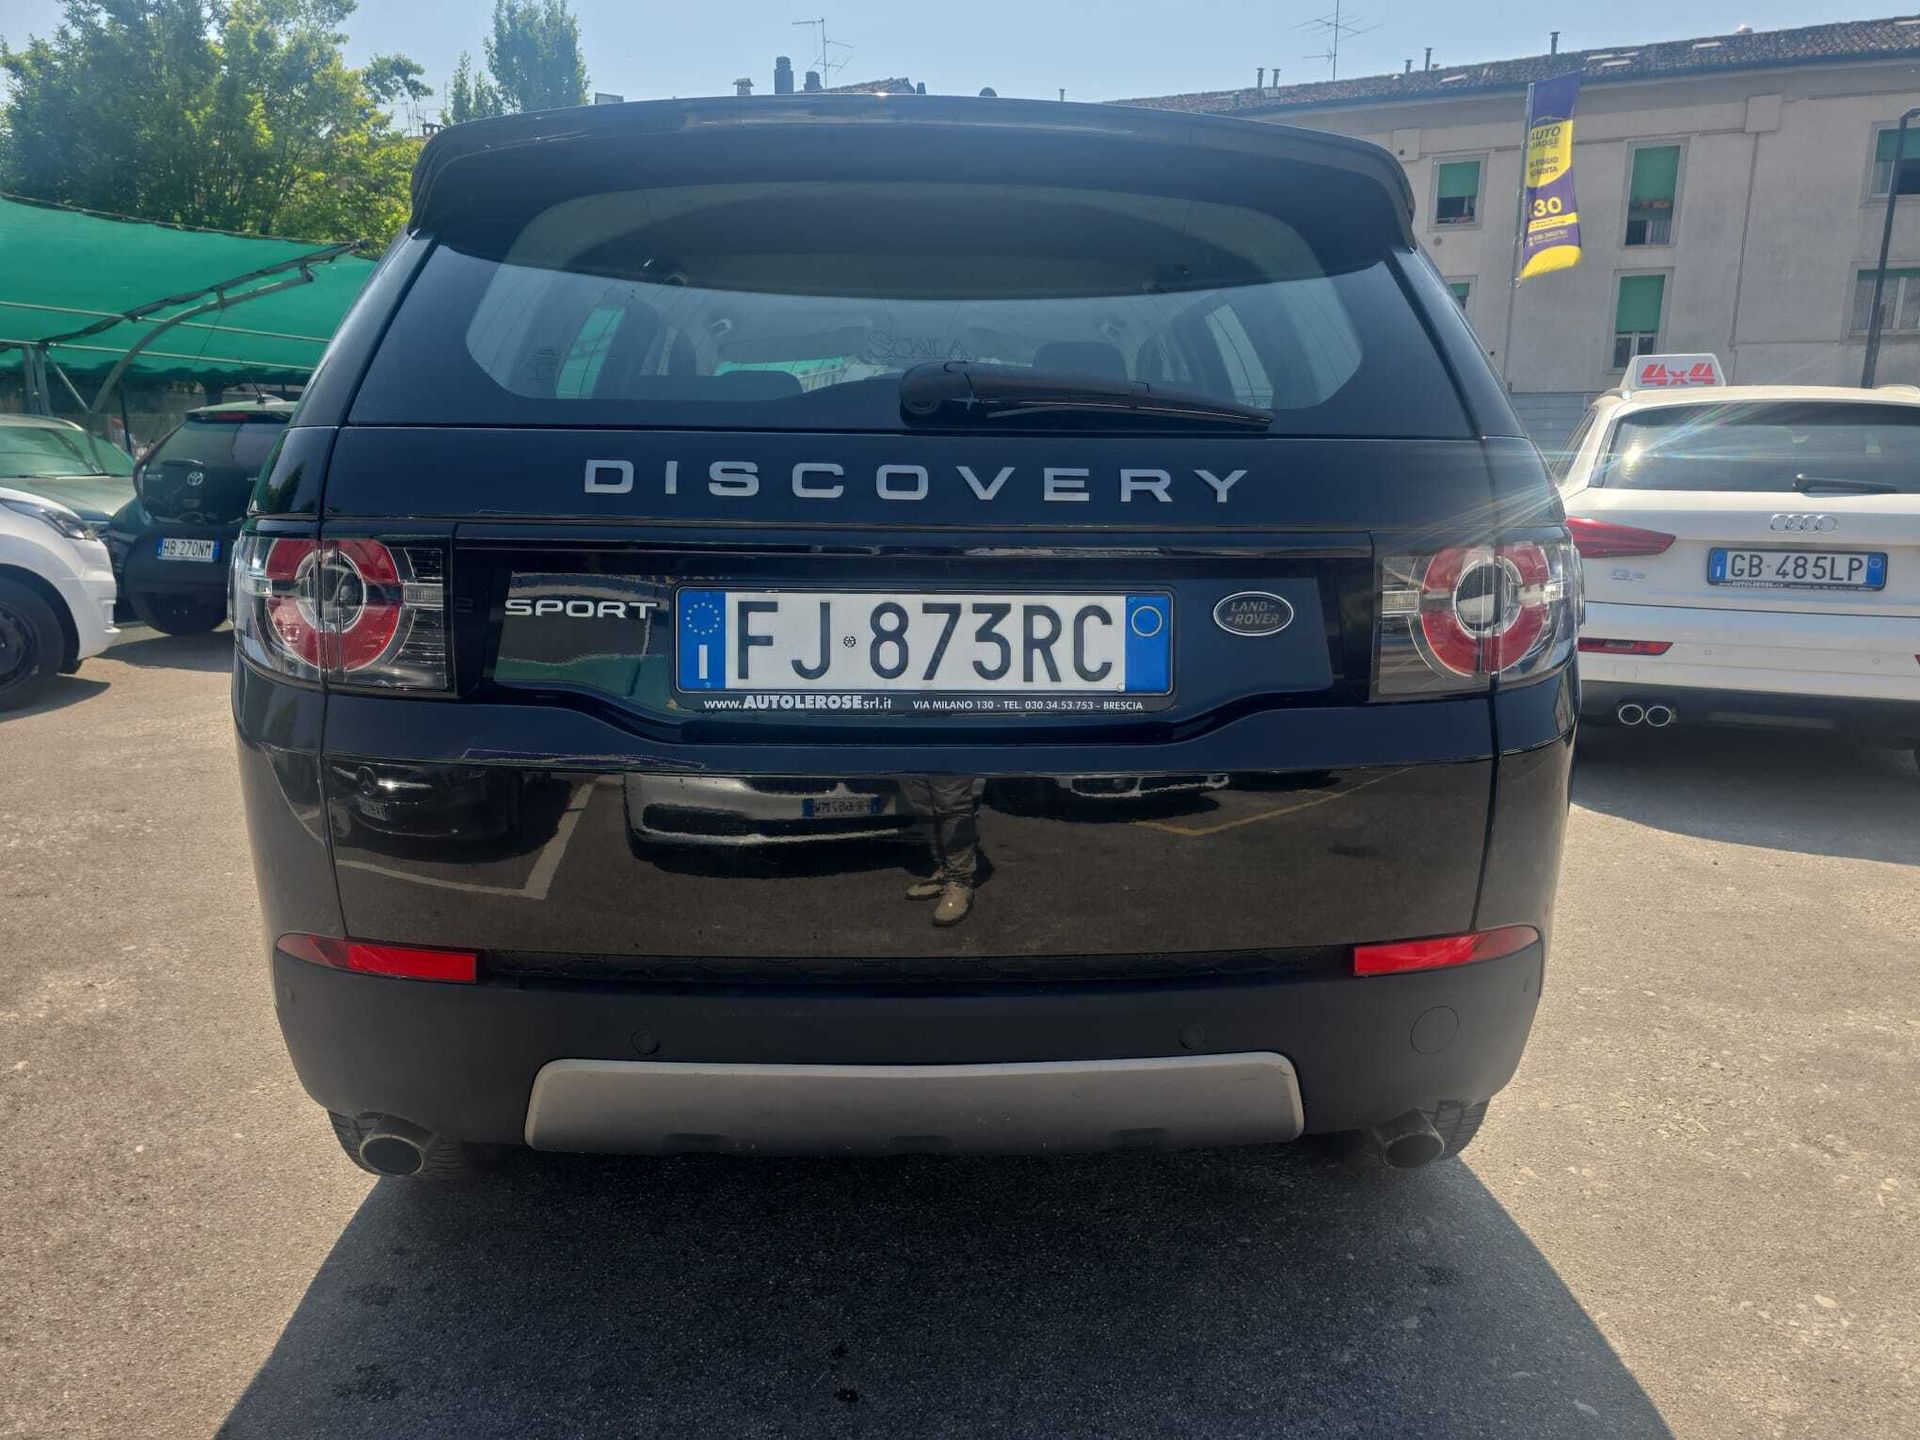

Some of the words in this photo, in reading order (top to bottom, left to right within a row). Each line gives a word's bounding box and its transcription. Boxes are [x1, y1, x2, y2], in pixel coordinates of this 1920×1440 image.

[1641, 362, 1716, 386] 4x4
[584, 459, 1248, 503] DISCOVERY
[1730, 554, 1764, 578] GB
[1775, 554, 1864, 582] 485LP
[504, 599, 658, 620] SPORT
[1231, 601, 1268, 612] LAND
[1235, 613, 1280, 625] ROVER
[737, 601, 831, 680] FJ
[869, 601, 1113, 682] 873RC
[703, 694, 892, 710] www.AUTOLEROSEsrl.it
[912, 700, 931, 710] VIA
[932, 700, 973, 710] MILANO
[976, 700, 994, 710] 130
[1025, 700, 1094, 710] 030.34.53.753
[1103, 701, 1144, 711] BRESCIA
